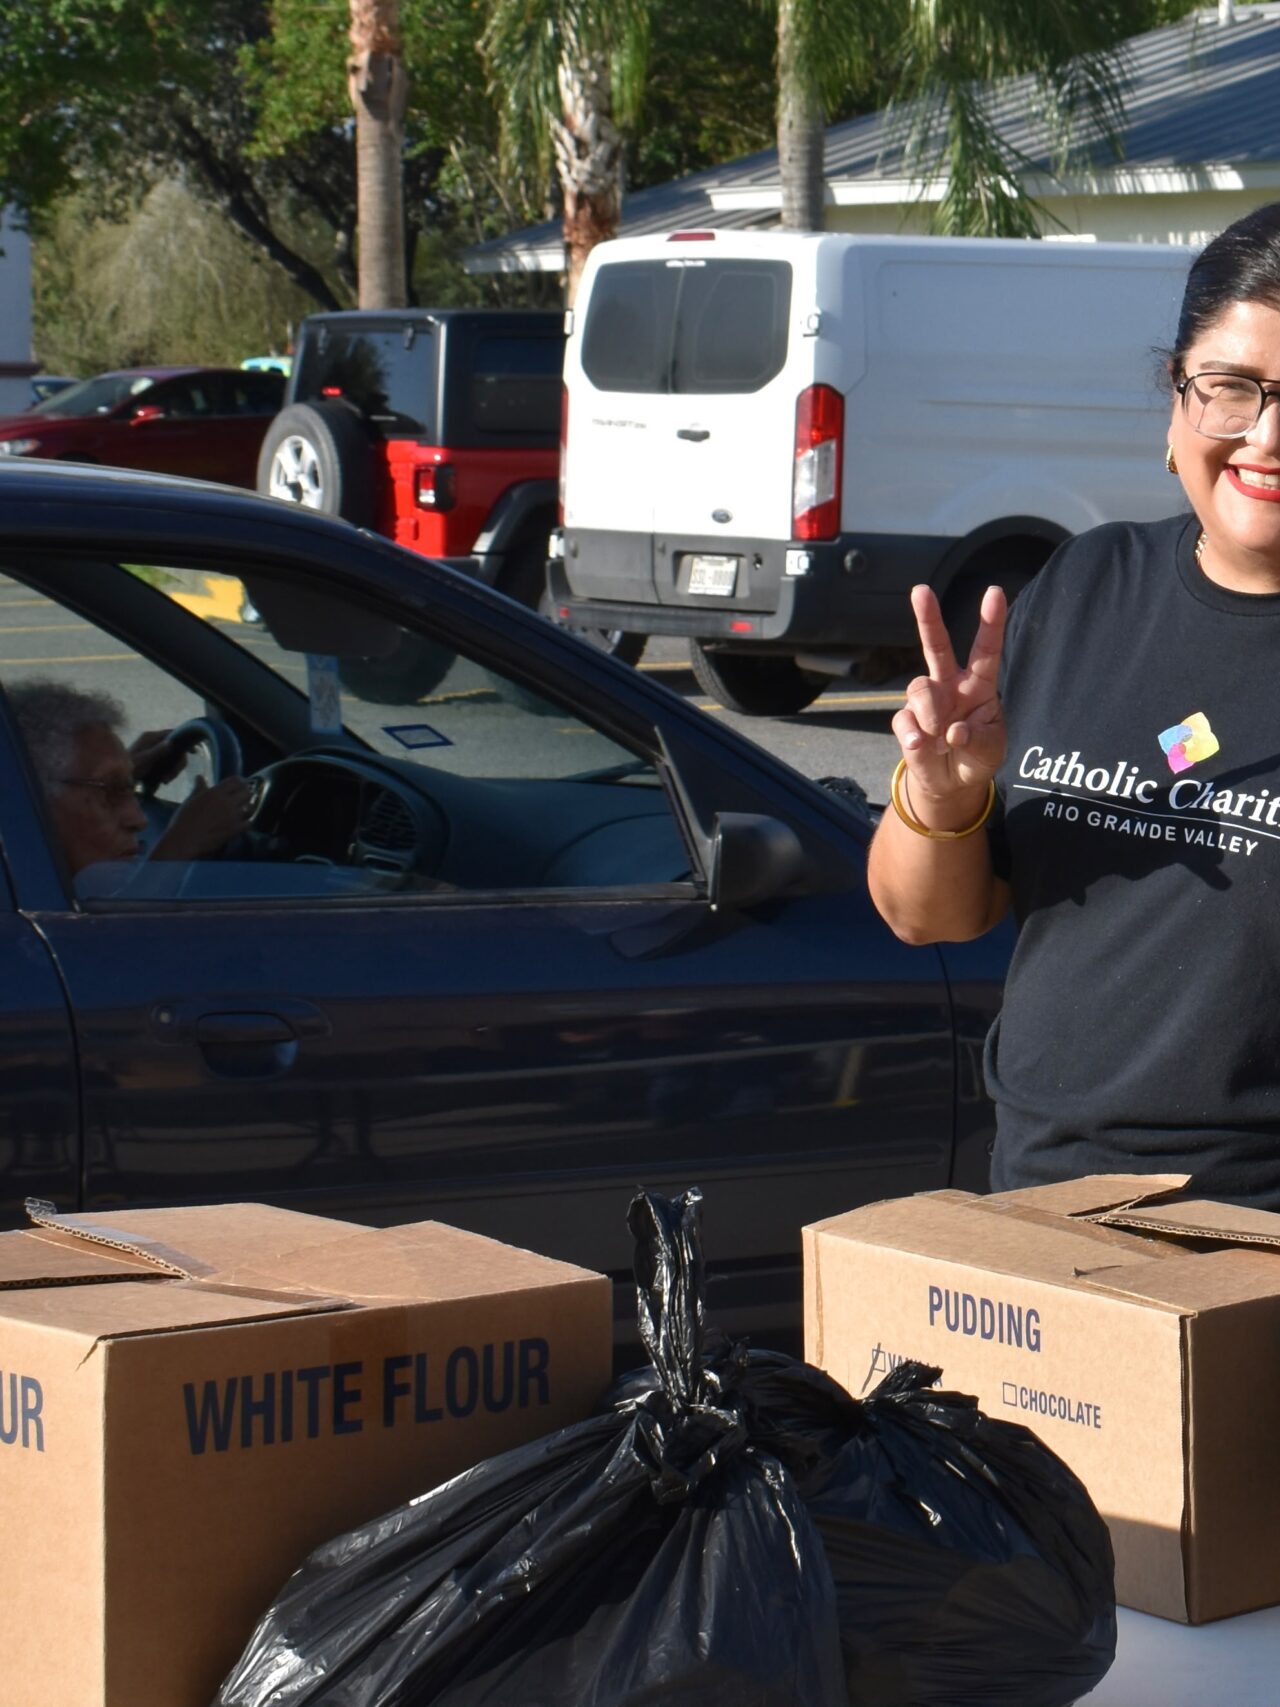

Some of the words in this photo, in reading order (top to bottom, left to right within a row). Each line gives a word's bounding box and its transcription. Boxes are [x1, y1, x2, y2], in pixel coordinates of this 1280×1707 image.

[1018, 745, 1158, 803] Catholic
[1043, 801, 1079, 822] RIO
[1087, 809, 1177, 842] GRANDE
[1183, 827, 1259, 856] VALLEY
[928, 1285, 1041, 1352] PUDDING
[183, 1361, 363, 1455] WHITE
[383, 1337, 551, 1428] FLOUR
[1020, 1386, 1102, 1429] CHOCOLATE
